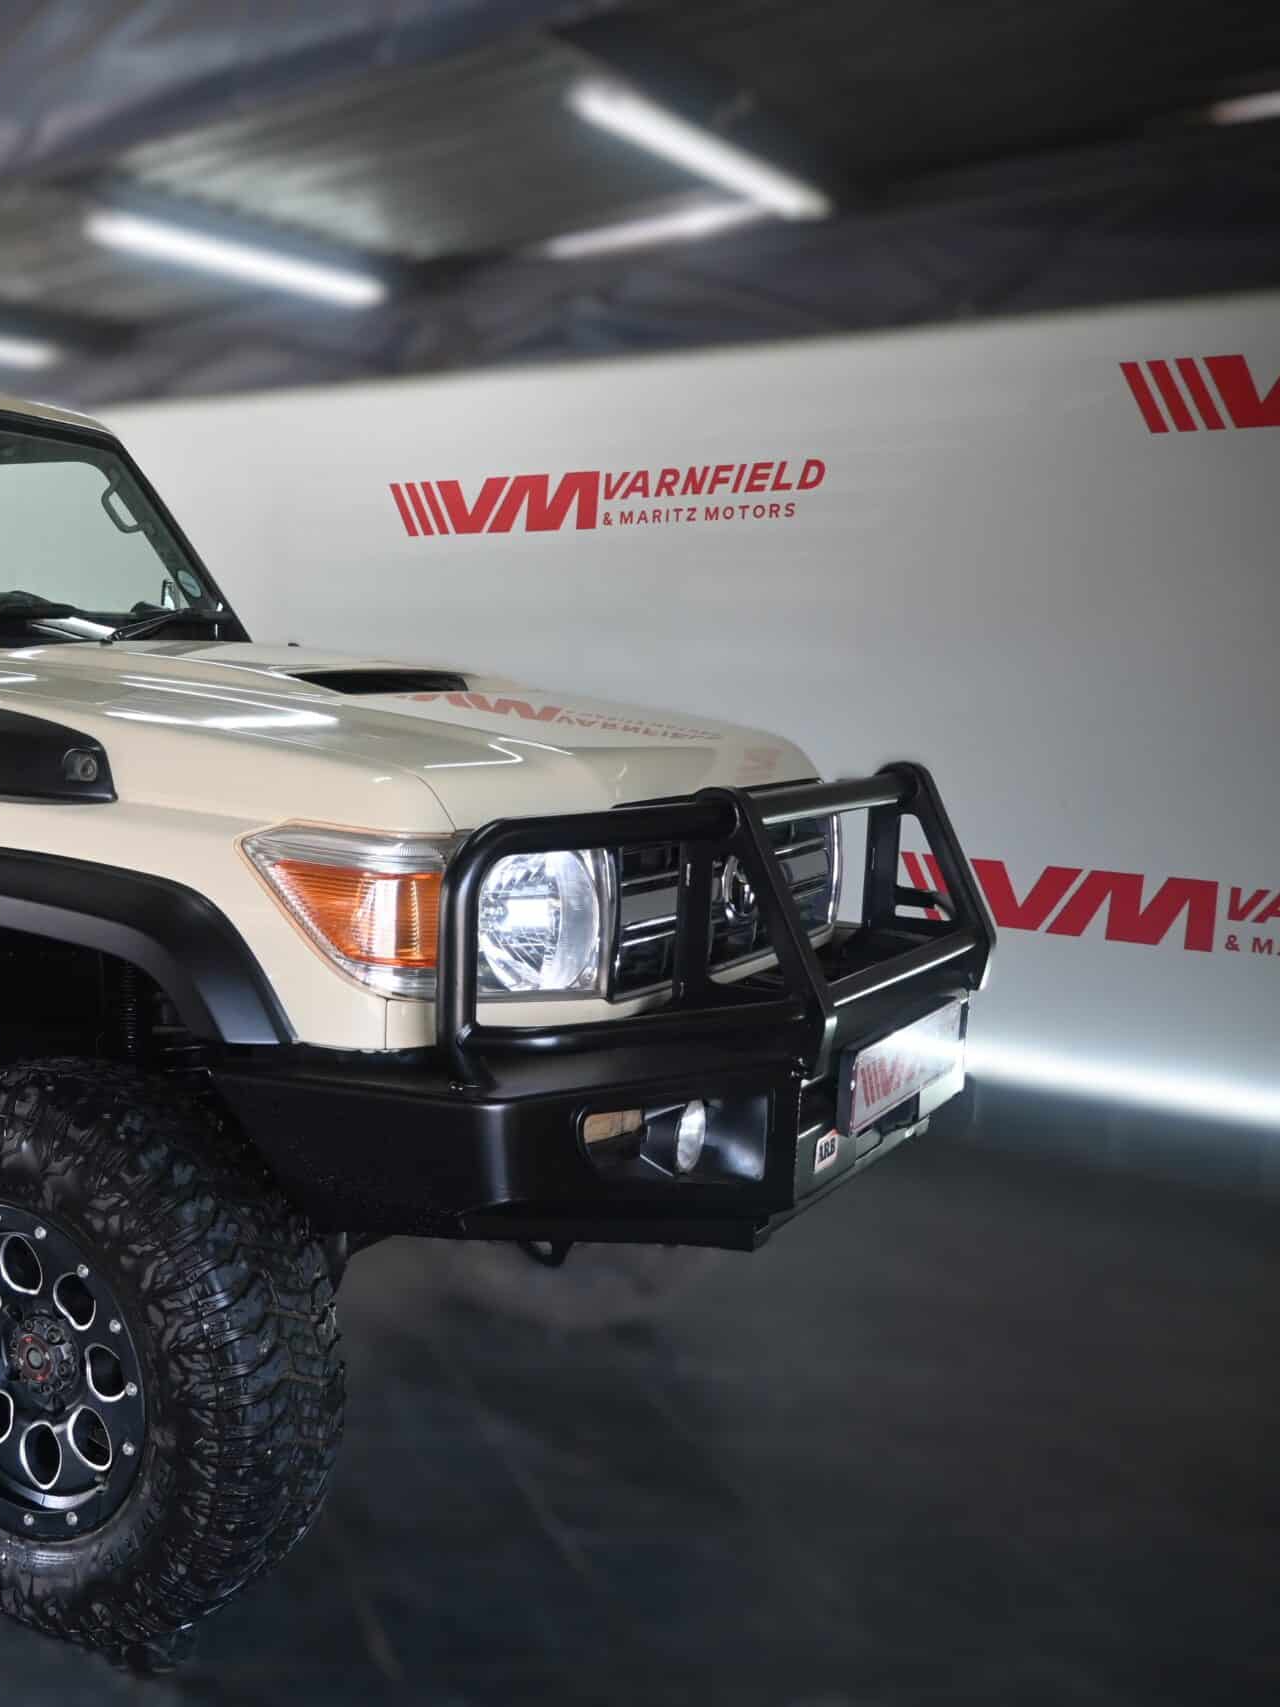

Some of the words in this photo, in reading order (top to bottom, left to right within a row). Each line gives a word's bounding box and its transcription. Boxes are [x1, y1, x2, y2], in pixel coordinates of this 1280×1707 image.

[603, 458, 826, 500] VARNFIELD
[435, 471, 600, 534] VM
[602, 511, 613, 526] &
[619, 507, 697, 525] MARITZ
[704, 502, 796, 521] MOTORS
[970, 858, 1218, 952] VM
[1224, 935, 1240, 952] &
[1252, 937, 1280, 956] M
[818, 1137, 836, 1165] ARB
